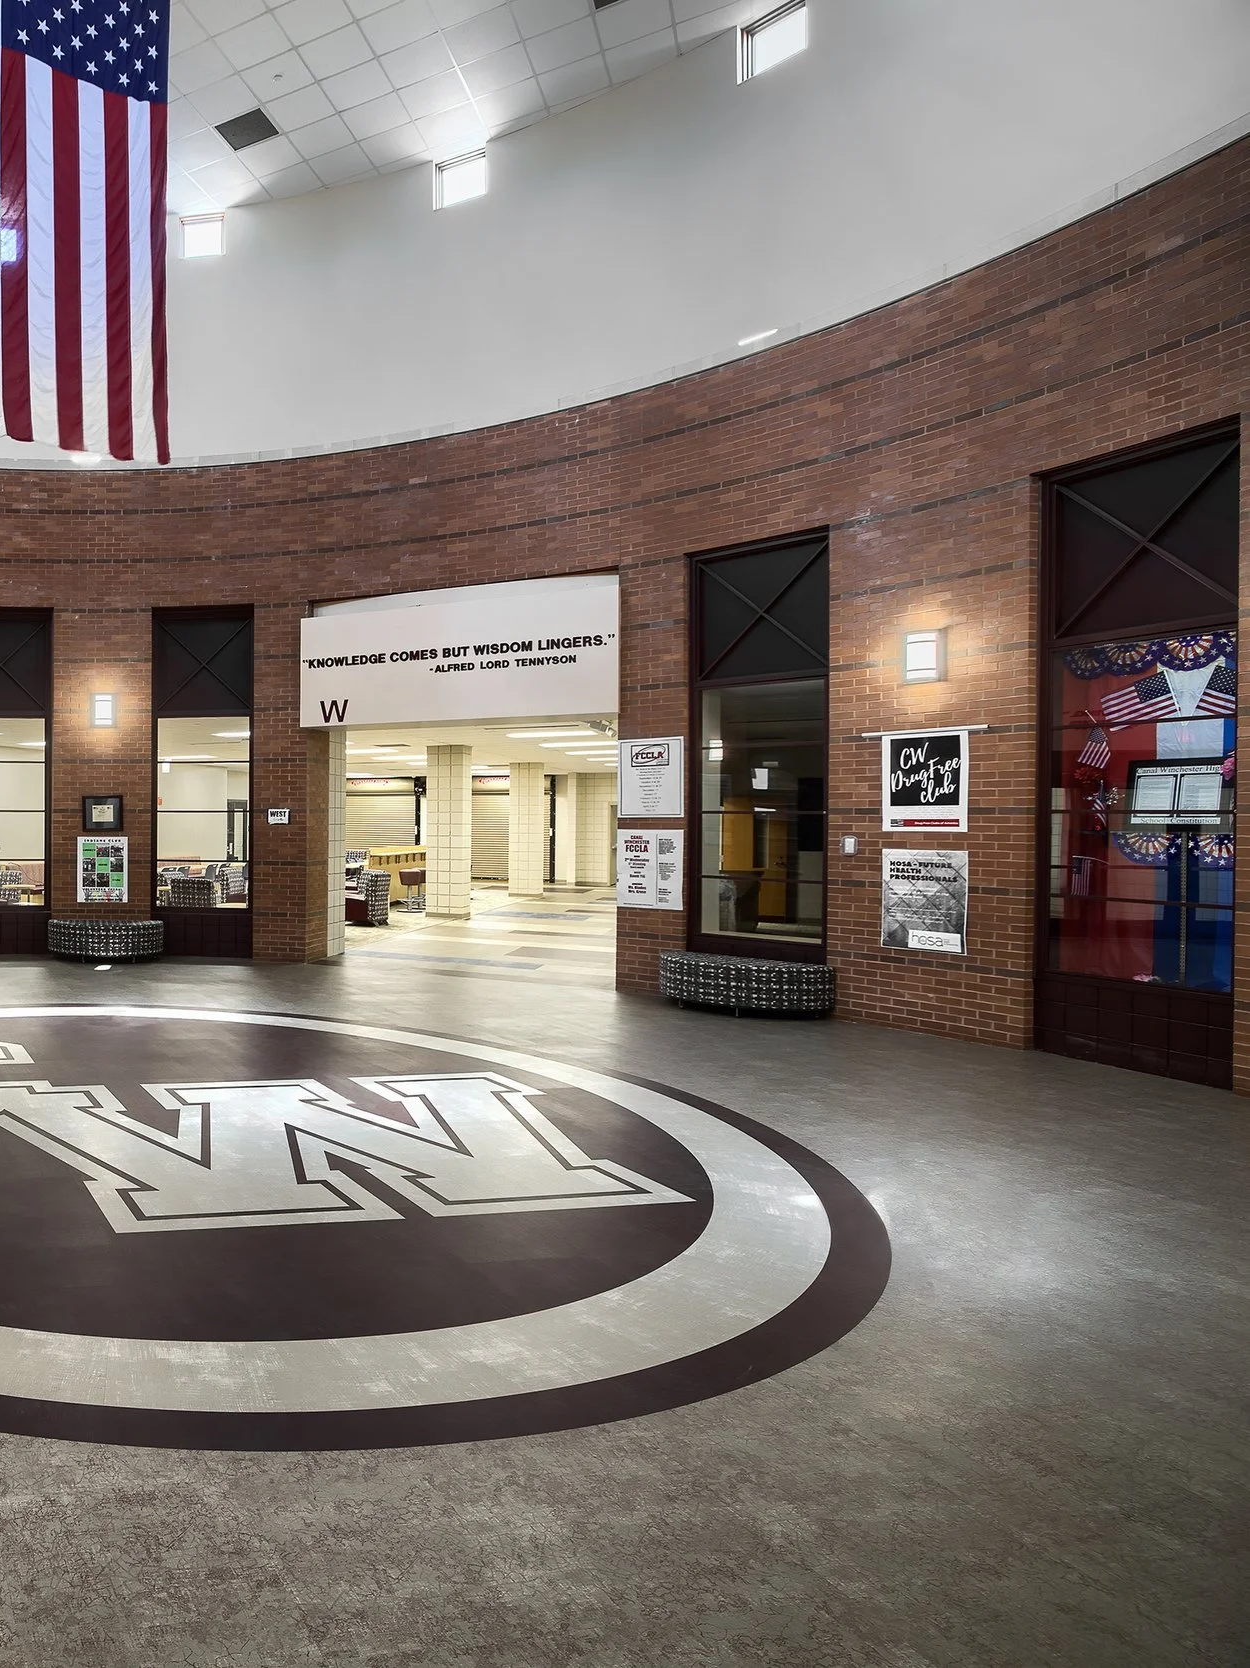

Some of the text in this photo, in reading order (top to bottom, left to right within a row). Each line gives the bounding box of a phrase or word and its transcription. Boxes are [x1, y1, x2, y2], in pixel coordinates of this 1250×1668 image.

[389, 648, 438, 663] COMES
[442, 645, 469, 659] BUT
[473, 640, 533, 656] WISDOM
[480, 659, 510, 670] LORD
[514, 654, 577, 668] TENNYSON
[320, 699, 349, 724] W
[900, 742, 929, 769] CW
[890, 874, 958, 882] PROFESSIONALS
[912, 931, 943, 947] hosa
